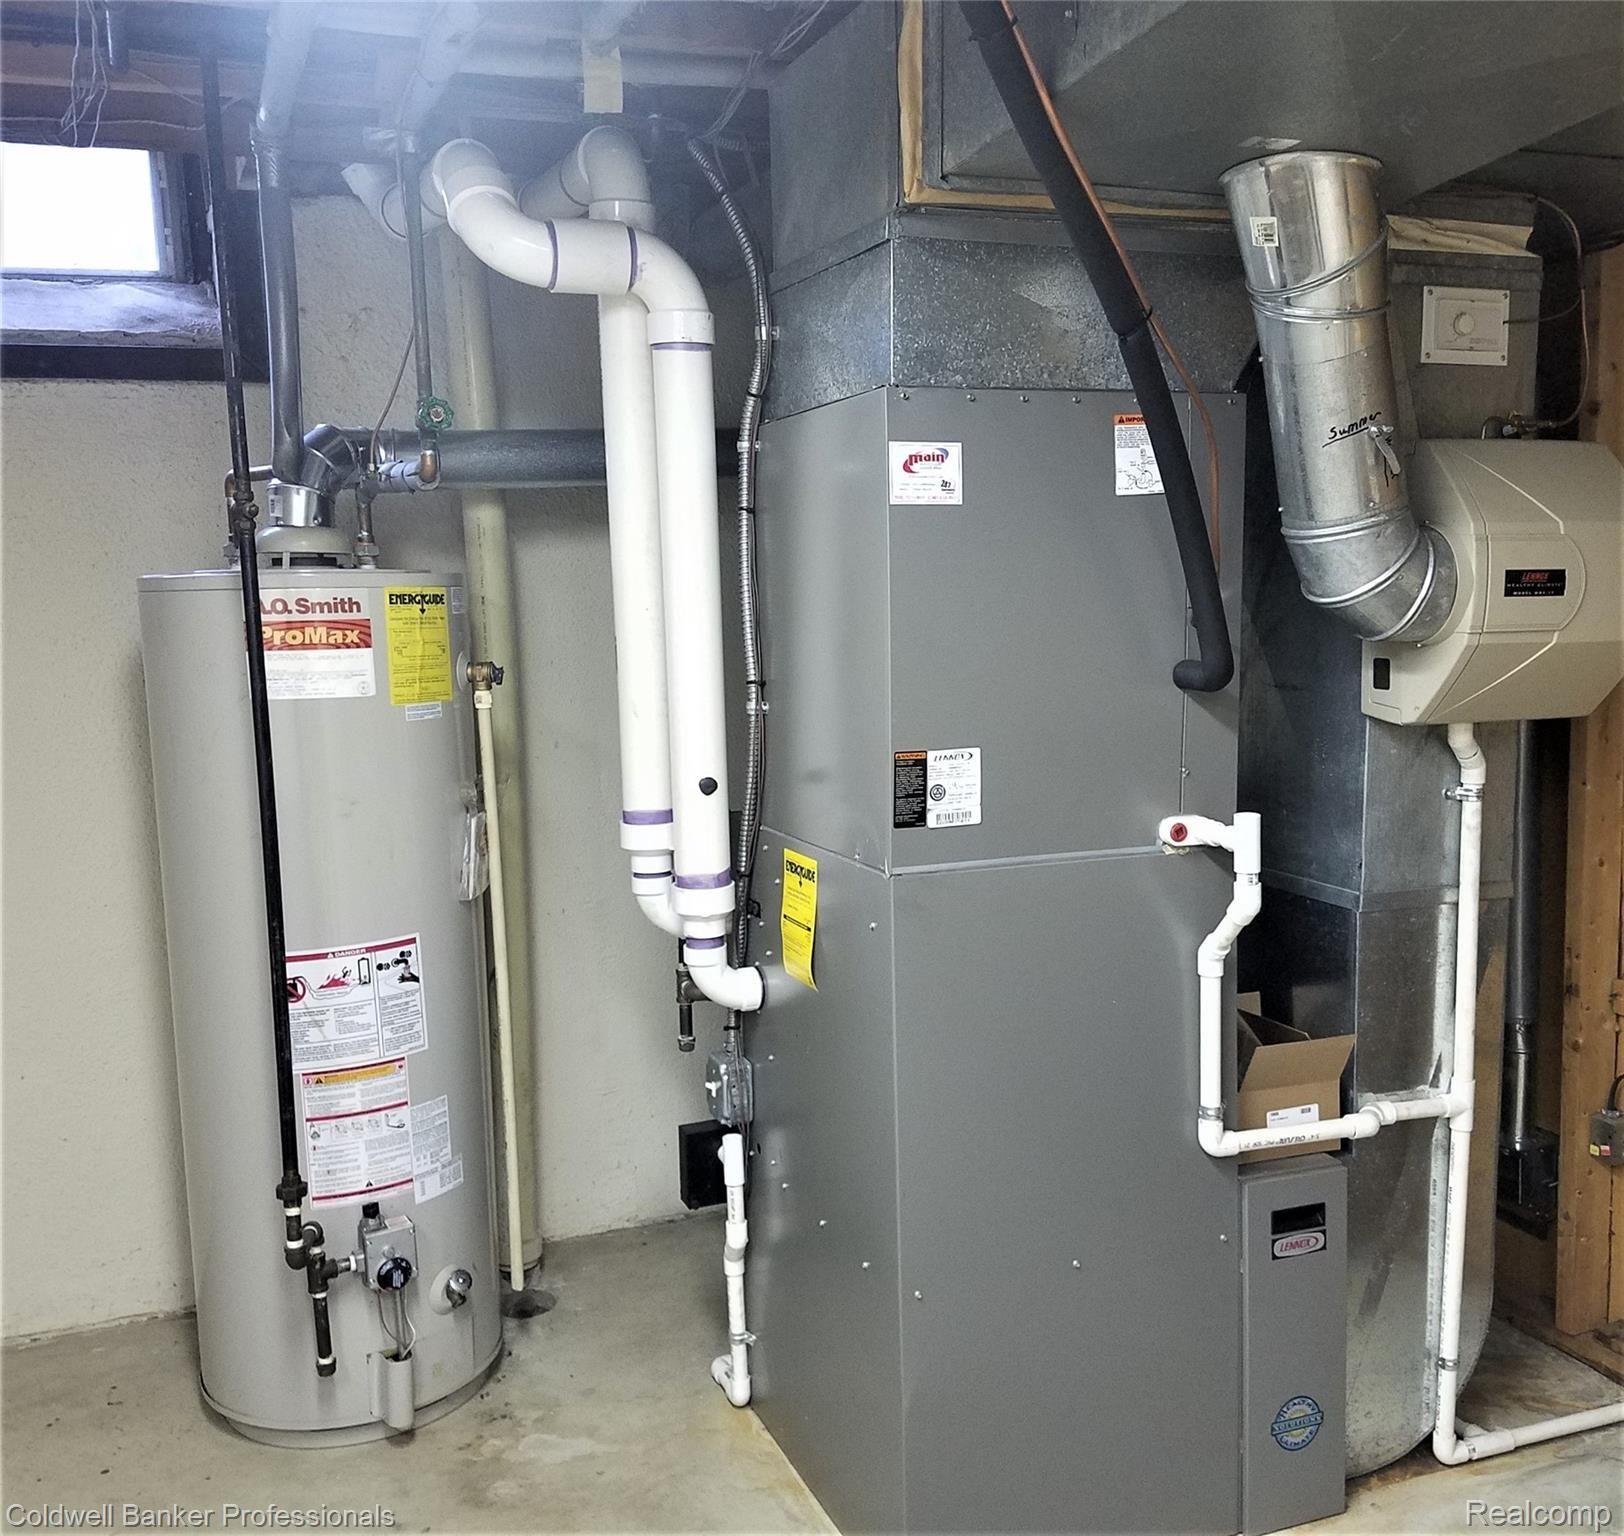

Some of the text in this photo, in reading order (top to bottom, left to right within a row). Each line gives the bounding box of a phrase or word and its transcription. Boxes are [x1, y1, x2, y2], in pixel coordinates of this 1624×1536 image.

[1327, 411, 1382, 441] Summer
[908, 452, 945, 467] main
[294, 597, 362, 615] Smith
[262, 626, 361, 646] ProMax
[334, 948, 367, 958] DANGER
[1280, 1238, 1311, 1252] LENNOX
